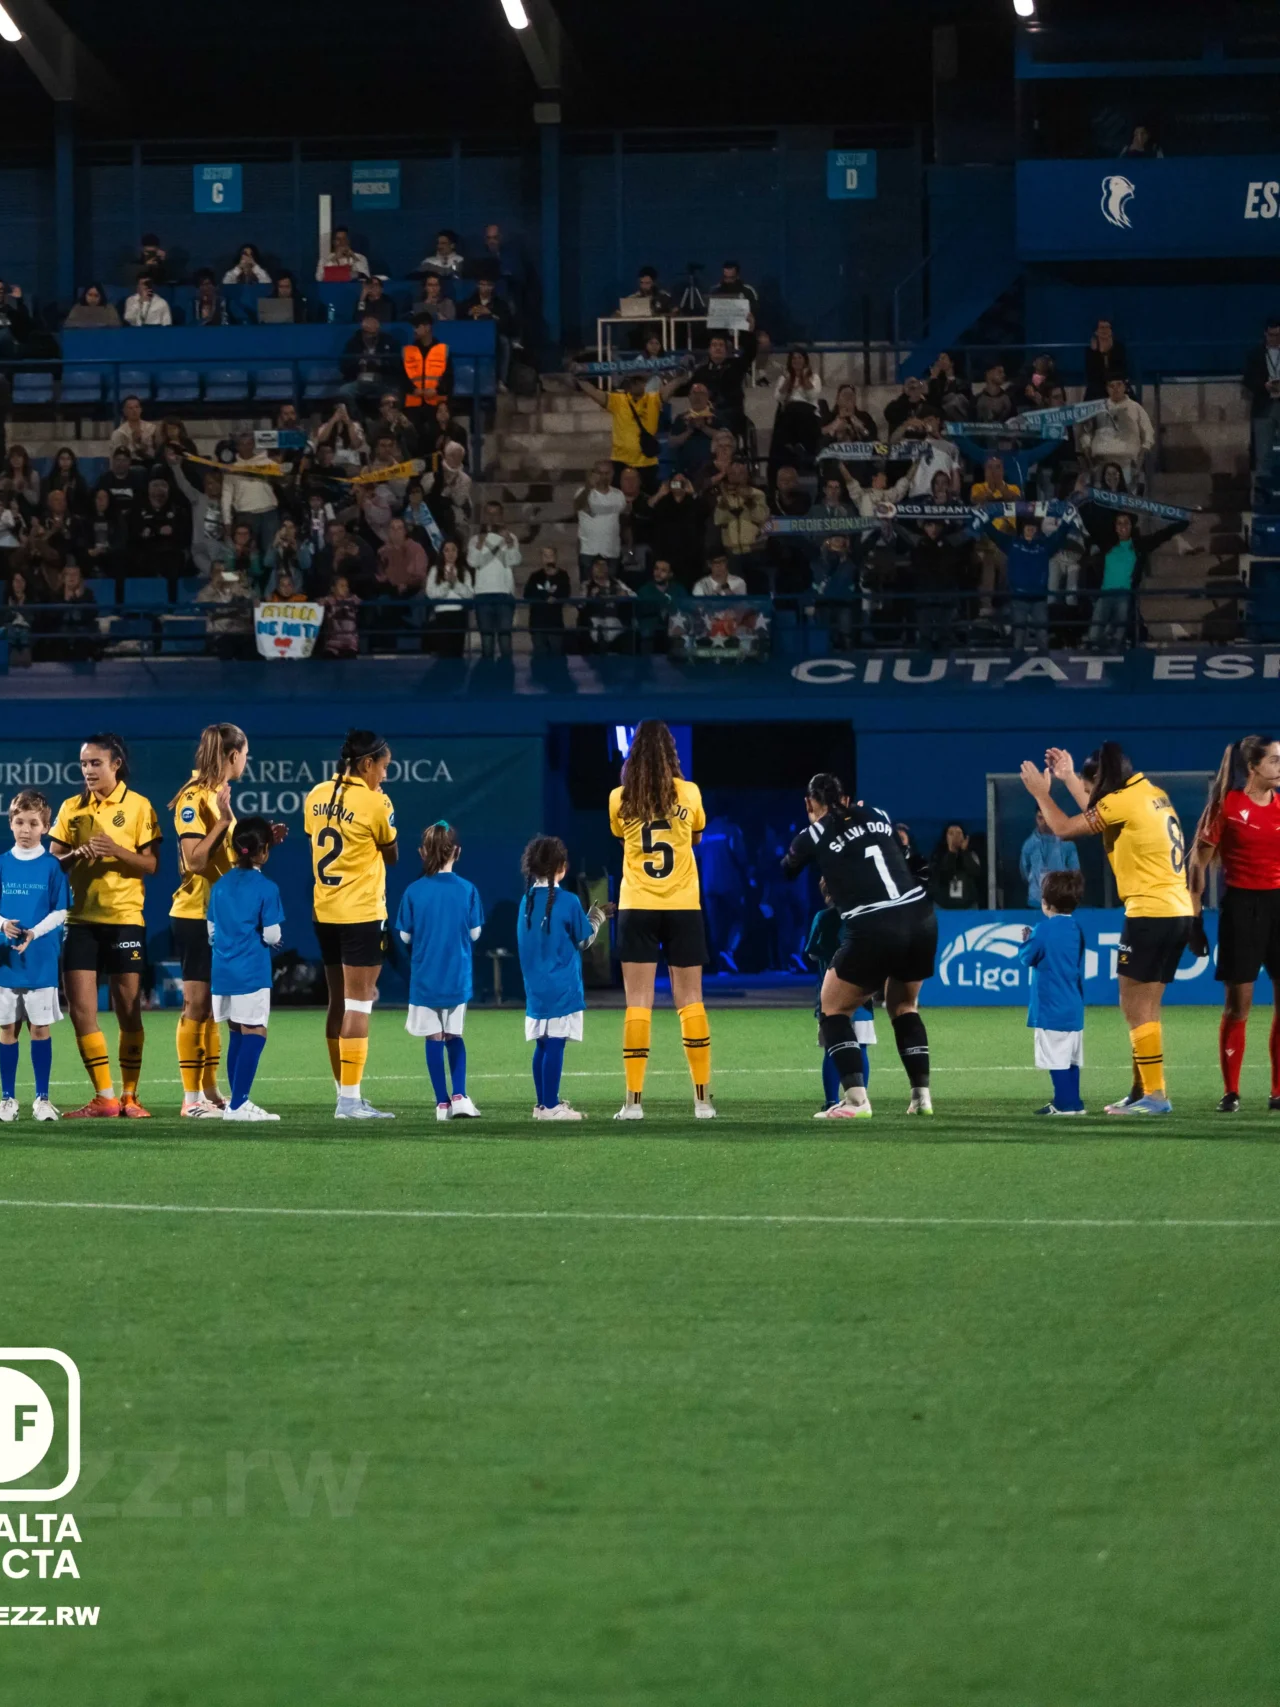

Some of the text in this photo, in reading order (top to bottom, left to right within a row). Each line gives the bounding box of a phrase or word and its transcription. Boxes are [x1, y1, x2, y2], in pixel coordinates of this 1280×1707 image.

[212, 183, 224, 203] C
[846, 169, 857, 190] D
[1243, 181, 1280, 219] ES
[593, 361, 616, 370] RCD
[826, 442, 873, 454] MADRID
[874, 443, 889, 454] VS
[896, 504, 970, 514] RCD ESPANY
[1093, 489, 1184, 518] RCD ESPANYOL
[791, 656, 1125, 685] CIUTAT
[317, 826, 343, 886] 2
[641, 819, 674, 879] 5
[1167, 815, 1184, 873] 8
[864, 844, 901, 900] 1
[111, 941, 142, 950] SKODA
[957, 961, 1020, 991] Liga
